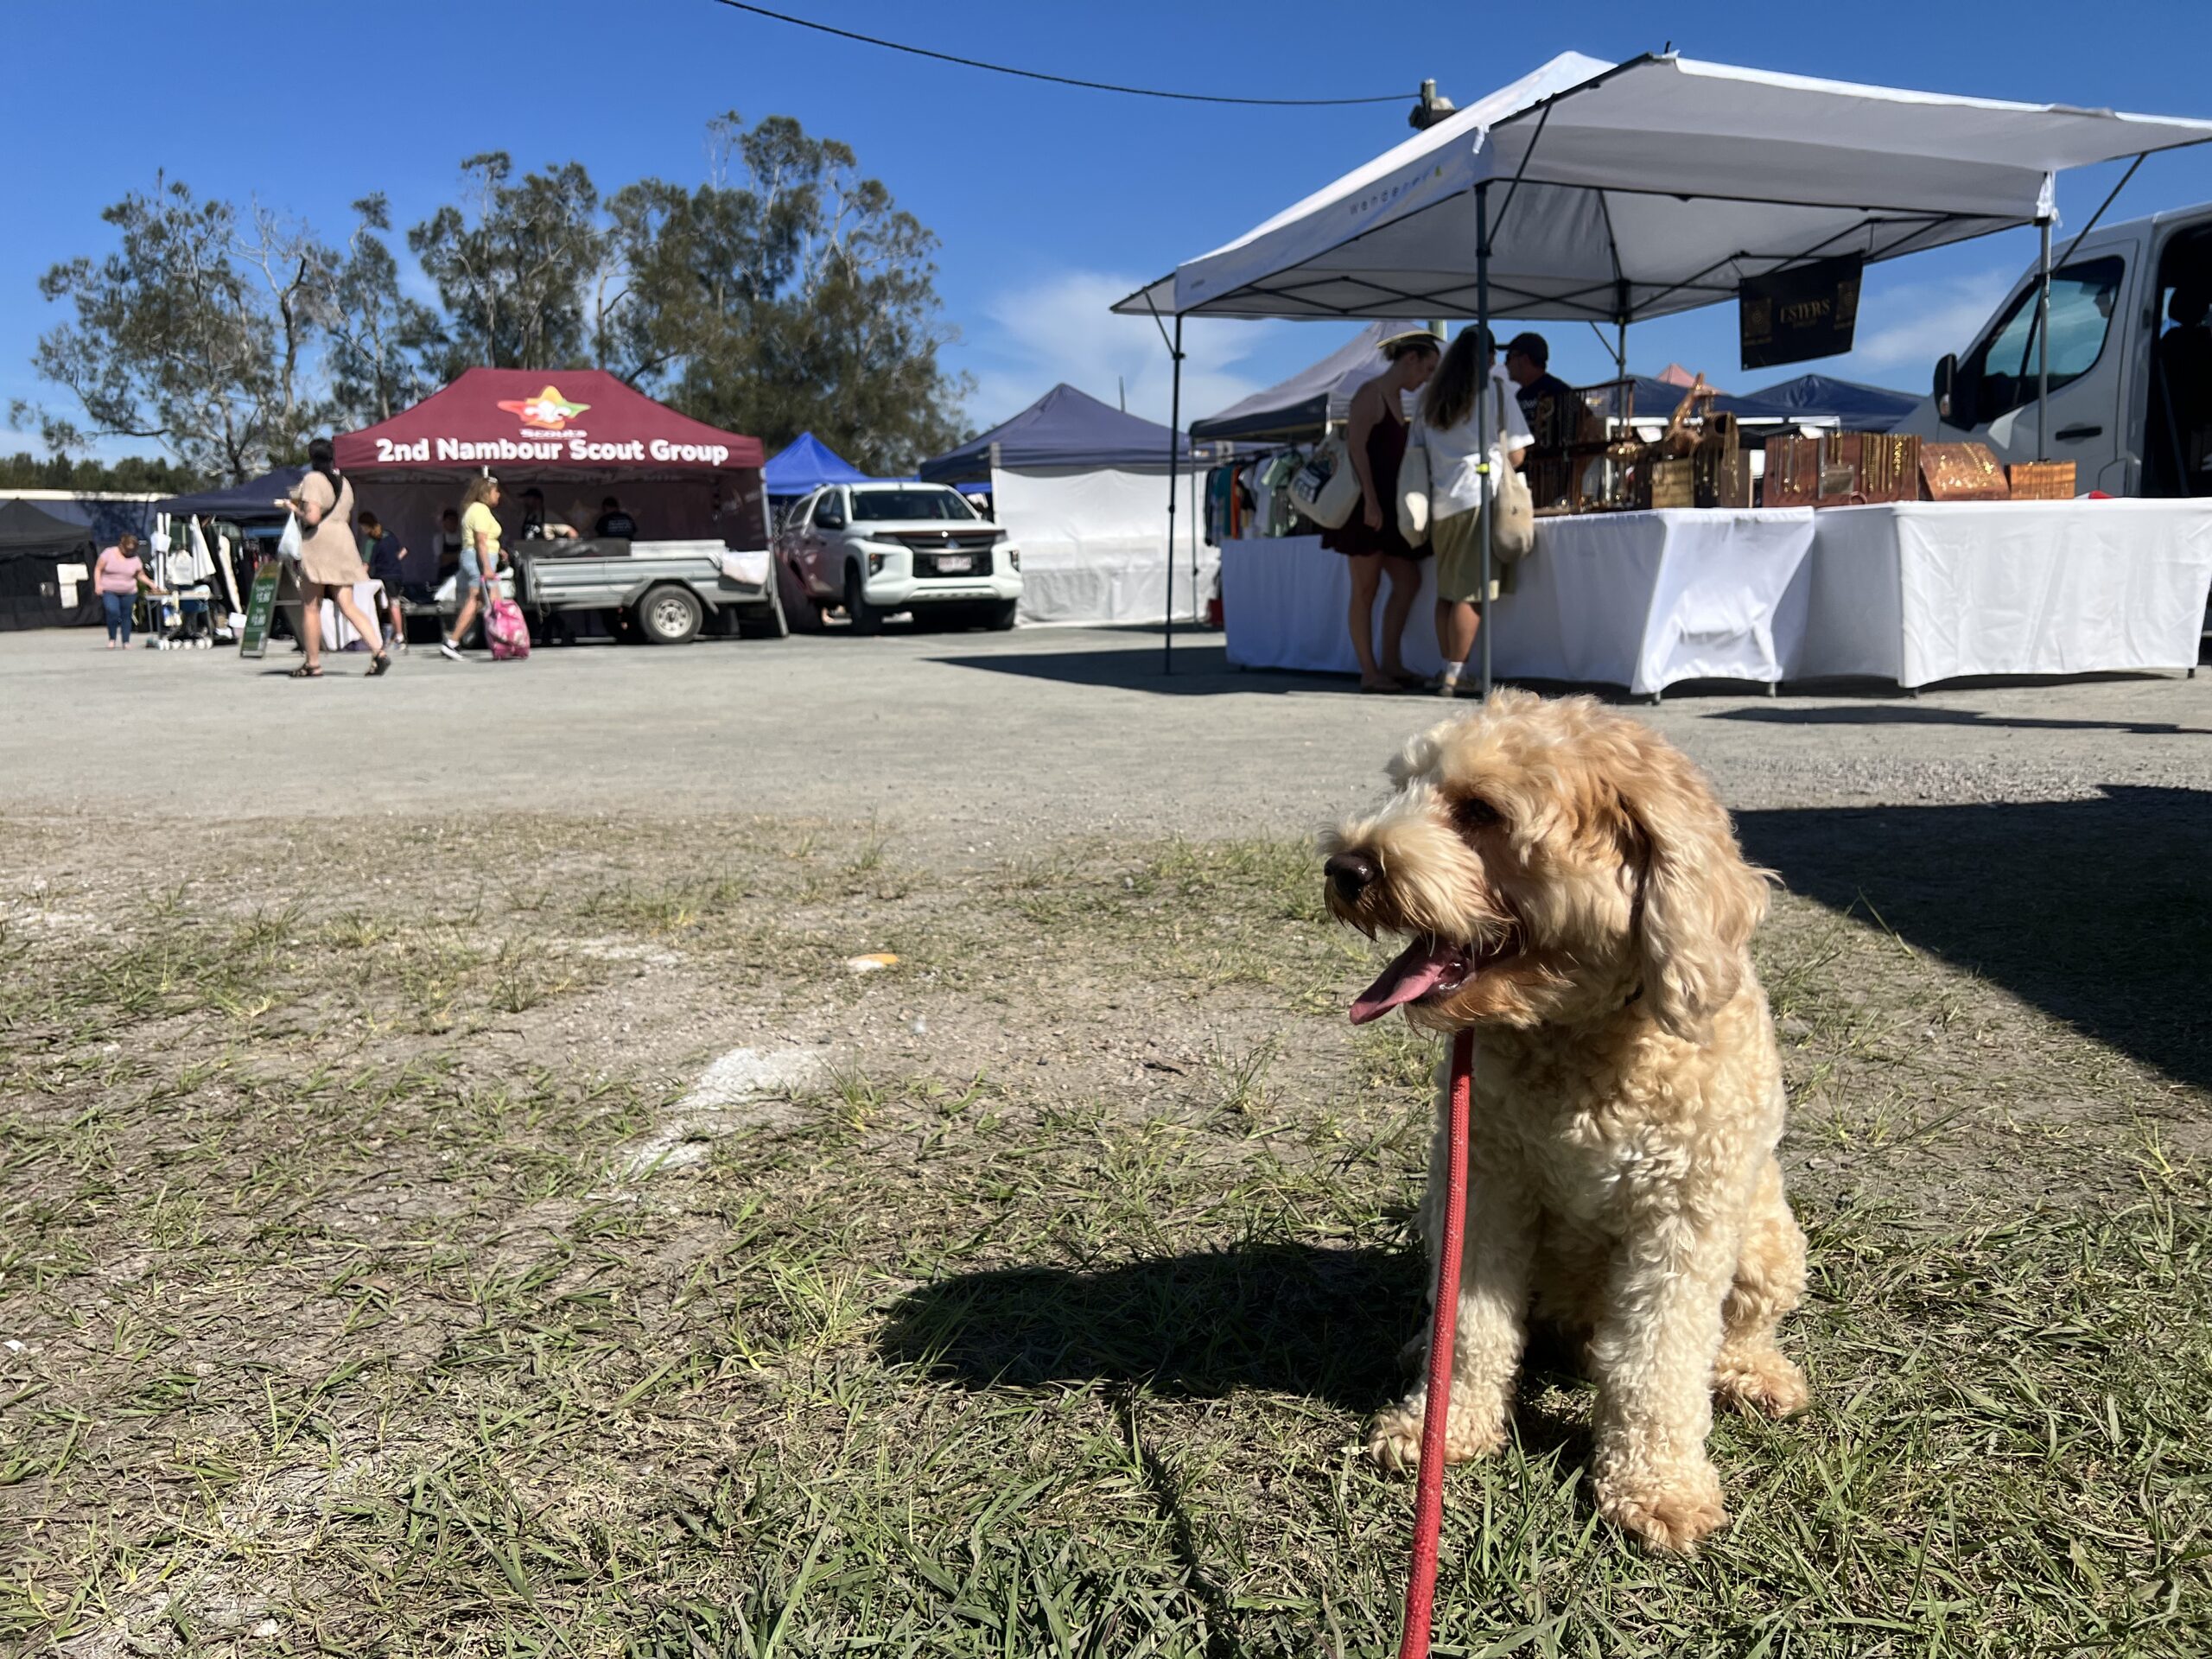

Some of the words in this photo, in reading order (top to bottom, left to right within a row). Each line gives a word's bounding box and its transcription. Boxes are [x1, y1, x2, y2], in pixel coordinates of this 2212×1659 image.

[375, 438, 430, 462] 2nd
[436, 438, 563, 461] Nambour
[569, 439, 645, 461] Scout
[650, 439, 729, 467] Group
